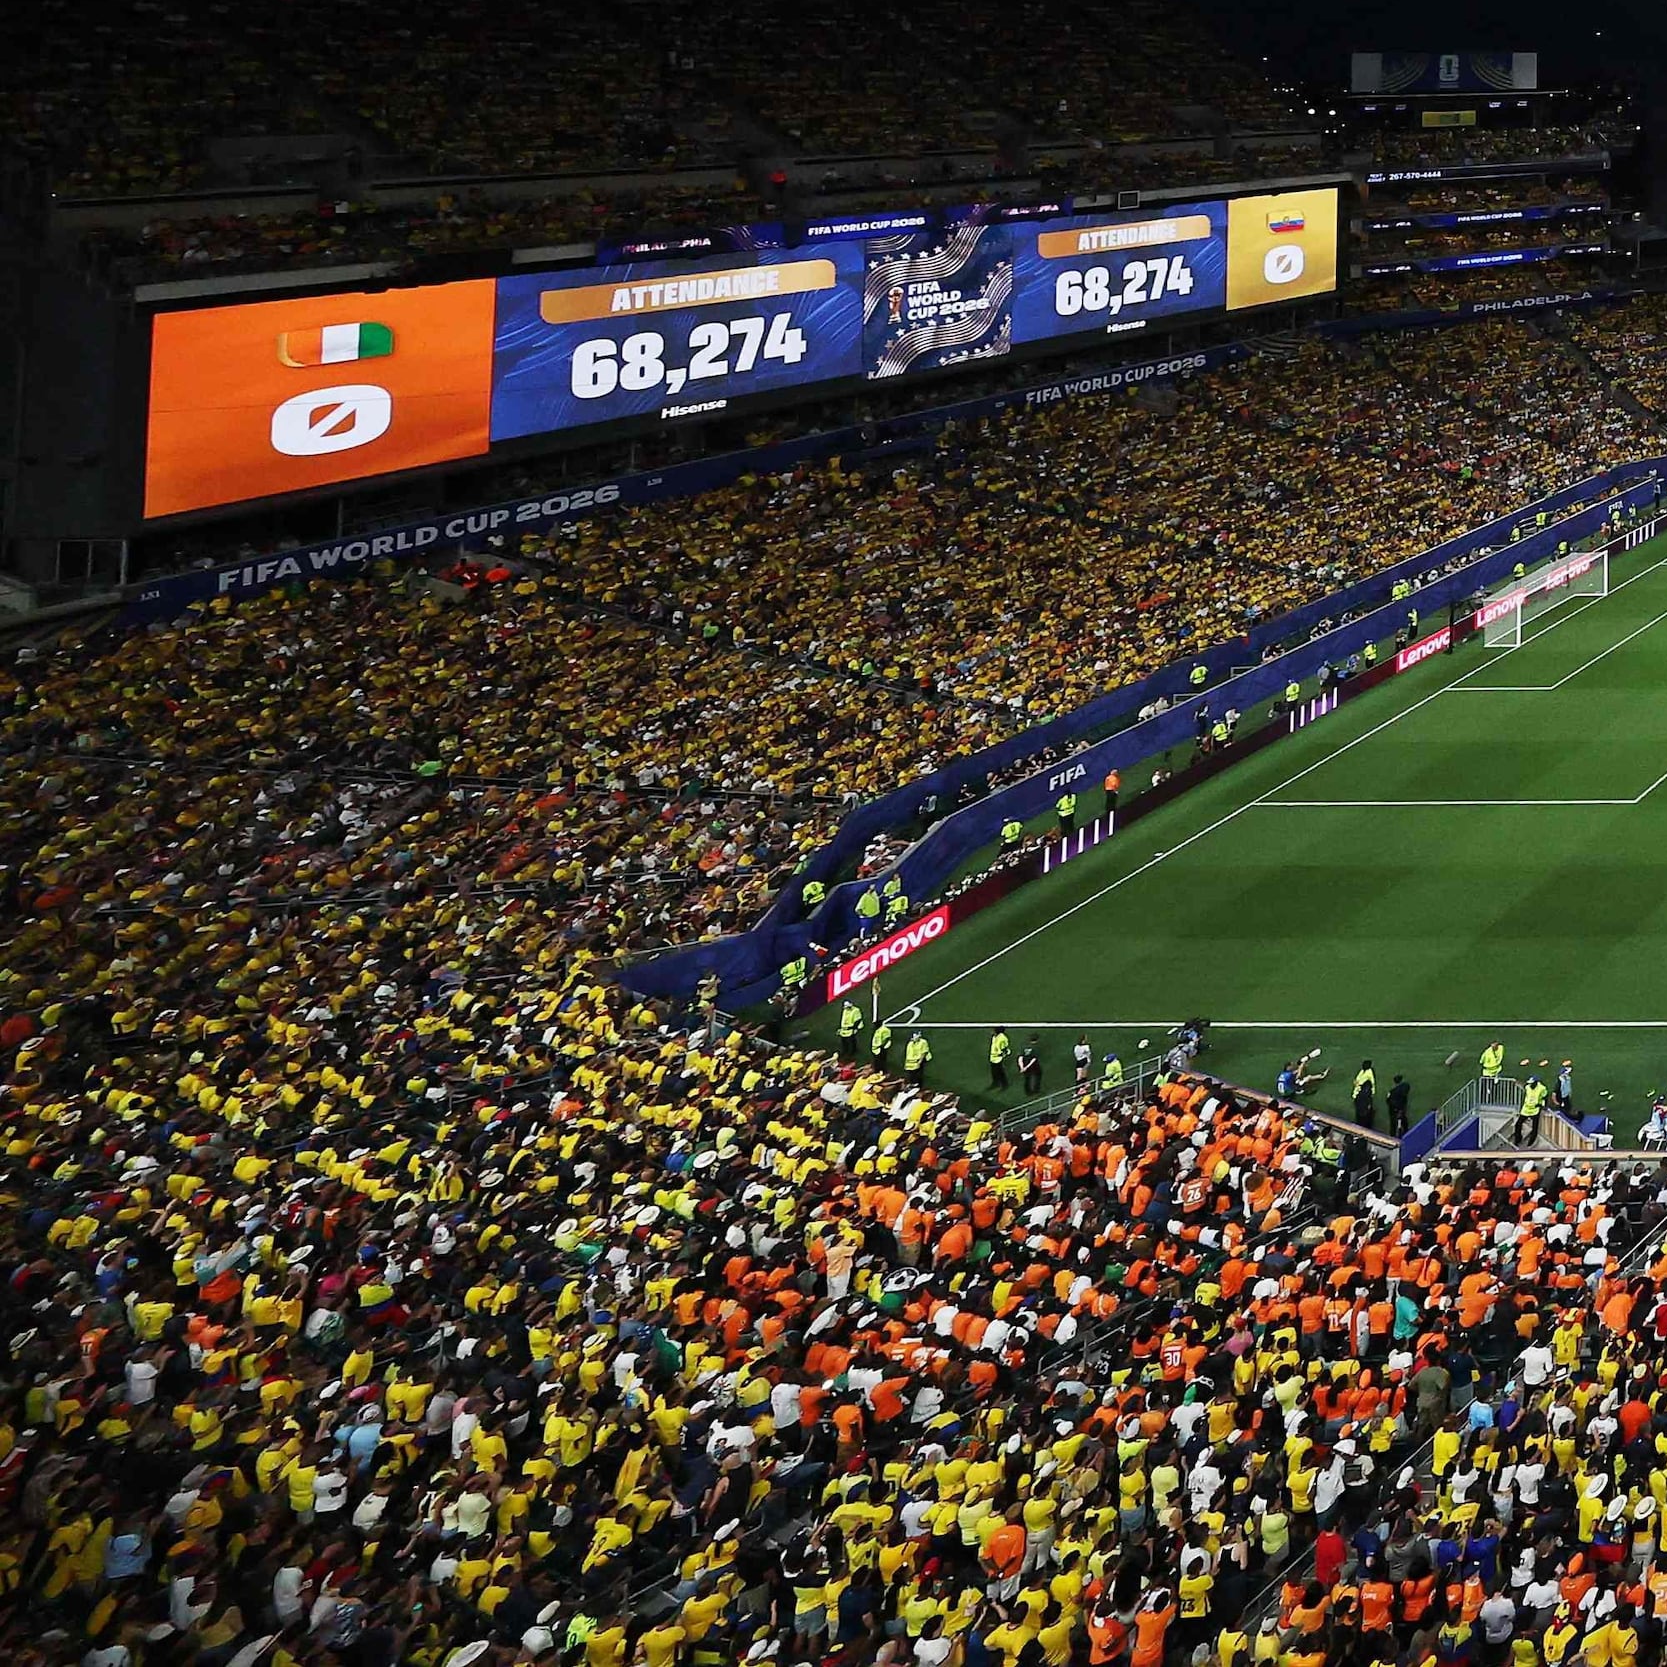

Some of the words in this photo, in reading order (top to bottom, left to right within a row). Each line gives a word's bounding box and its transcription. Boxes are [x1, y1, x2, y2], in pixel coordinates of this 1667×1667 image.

[808, 224, 831, 237] FIFA
[832, 222, 866, 235] WORLD
[867, 220, 890, 232] CUP
[891, 216, 925, 230] 2026
[1078, 221, 1178, 252] ATTENDANCE
[622, 236, 712, 255] PHILADLPHIA
[1264, 244, 1306, 285] 0
[611, 271, 779, 313] ATTENDANCE
[908, 280, 940, 297] FIFA
[1055, 254, 1194, 316] 68,274
[907, 290, 962, 309] WORLD
[907, 303, 940, 320] CUP
[938, 299, 990, 316] 2026
[1473, 291, 1593, 313] PHILADELPHA
[1106, 318, 1147, 334] Hisense
[571, 313, 806, 399] 68,274
[1025, 384, 1063, 407] FIFA
[1065, 373, 1122, 398] WORLD
[1124, 365, 1155, 385] CUP
[1156, 354, 1208, 375] 2026
[271, 384, 393, 457] 0
[661, 397, 727, 420] Hisense
[218, 556, 302, 593] FIFA
[307, 525, 441, 572] WORLD
[445, 507, 511, 540] CUP
[514, 485, 622, 523] 2026
[1048, 762, 1088, 792] FIFA
[832, 914, 946, 999] Lenovo
[1188, 1188, 1202, 1202] 26
[1165, 1351, 1181, 1366] 30
